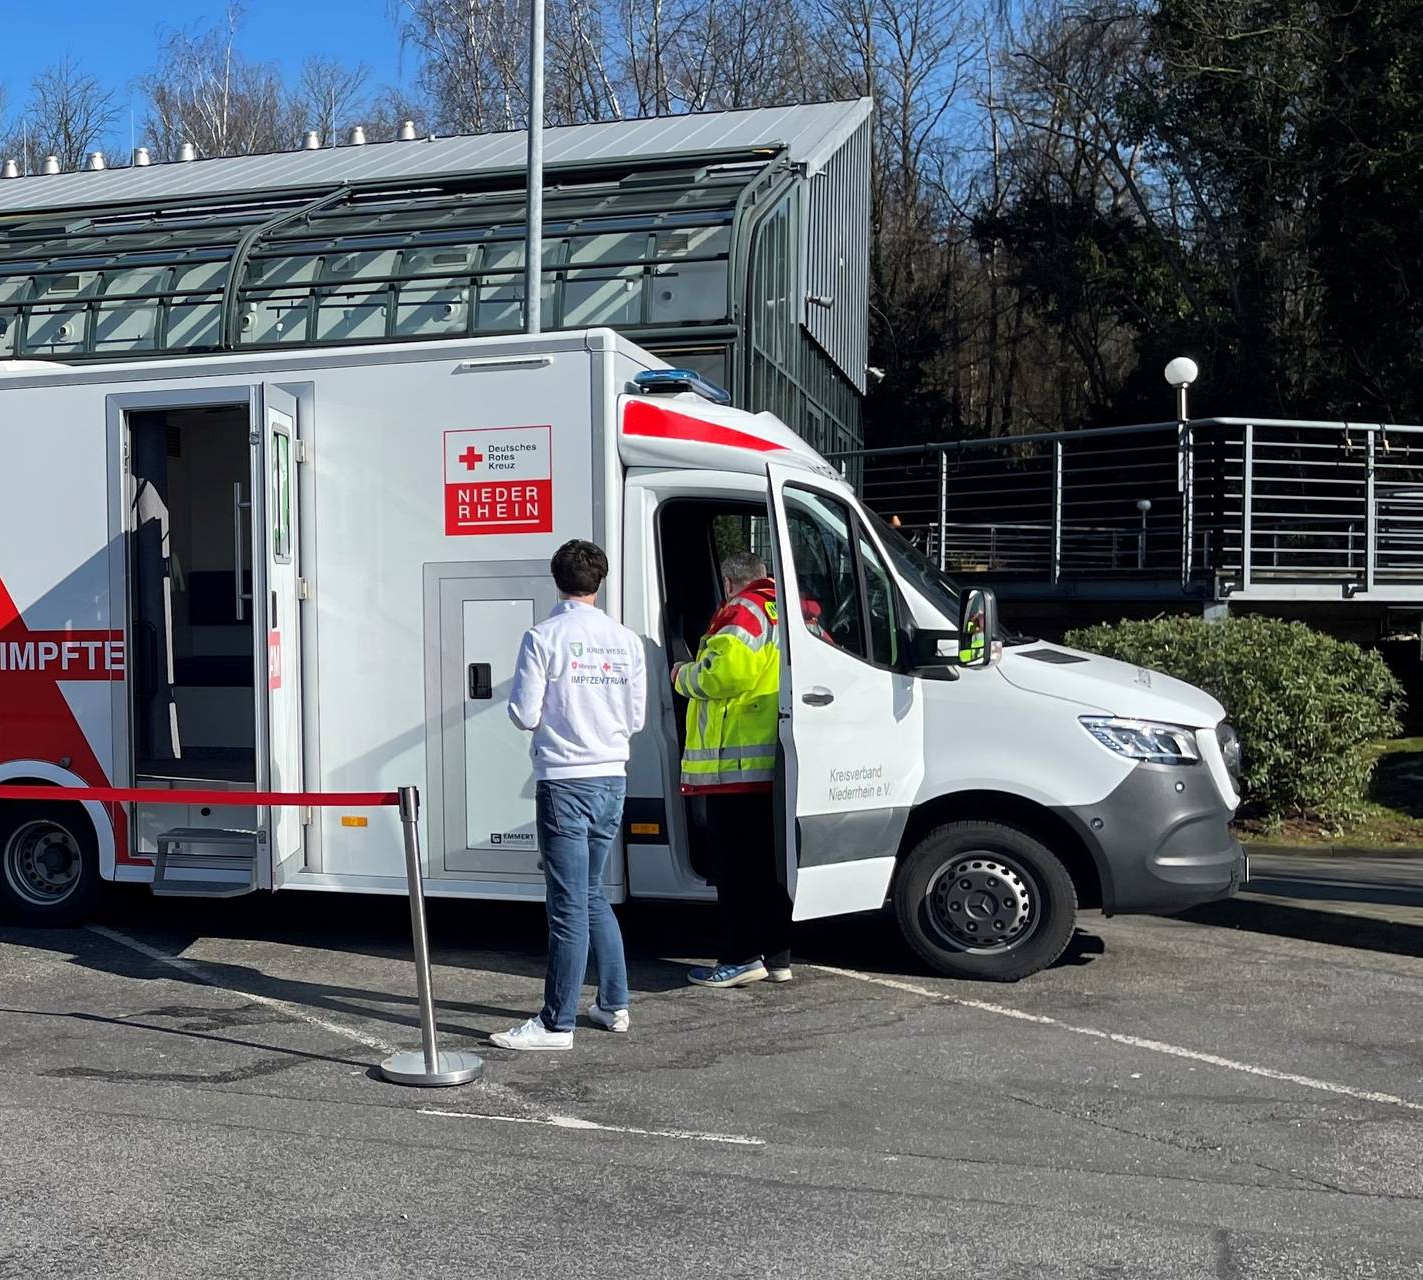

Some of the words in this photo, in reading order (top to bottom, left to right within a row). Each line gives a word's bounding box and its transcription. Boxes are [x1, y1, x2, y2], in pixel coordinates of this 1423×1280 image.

[488, 443, 537, 453] Deutsches
[488, 453, 515, 462] Rotes
[488, 462, 516, 471] Kreuz
[458, 486, 538, 503] NIEDER
[458, 502, 539, 519] RHEIN
[0, 641, 125, 671] IMPFTE
[571, 675, 628, 686] IMPFZENTRUM
[830, 764, 882, 782] Kreisverband
[828, 785, 875, 801] Niederrhein
